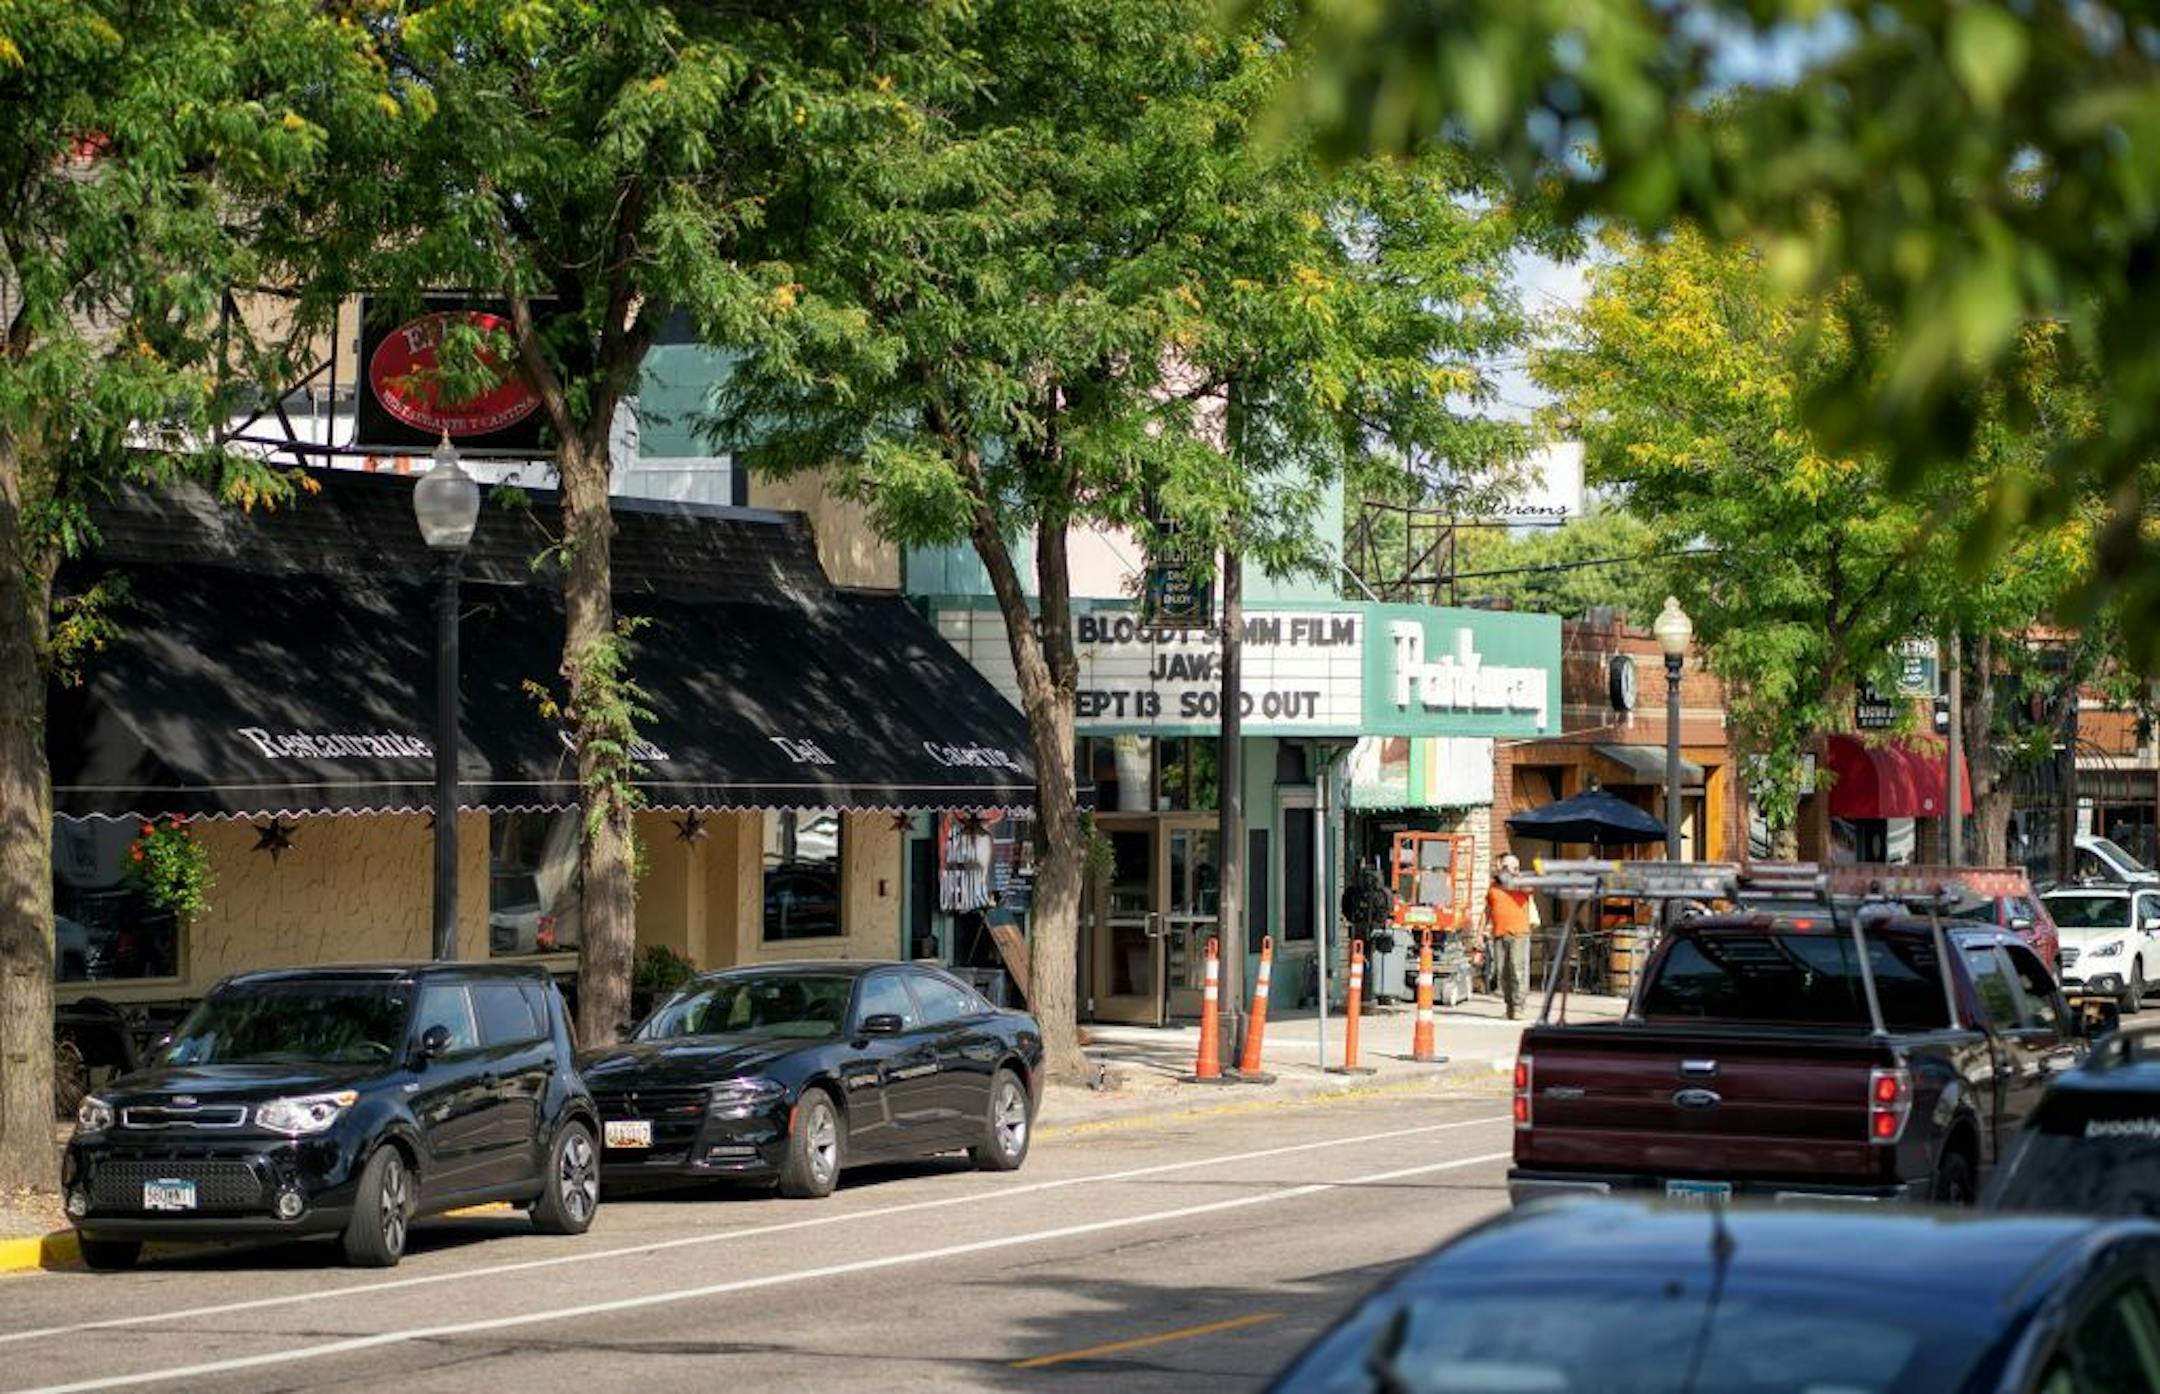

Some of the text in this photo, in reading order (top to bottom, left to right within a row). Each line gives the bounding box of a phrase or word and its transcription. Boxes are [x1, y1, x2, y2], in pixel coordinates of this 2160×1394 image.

[1290, 617, 1355, 646] FILM
[1076, 690, 1129, 718] EPT
[1181, 690, 1254, 719] SOD
[1262, 690, 1320, 720] OUT
[237, 726, 434, 759] Restaurante
[769, 736, 836, 765] Deli
[922, 740, 1023, 773] Catering
